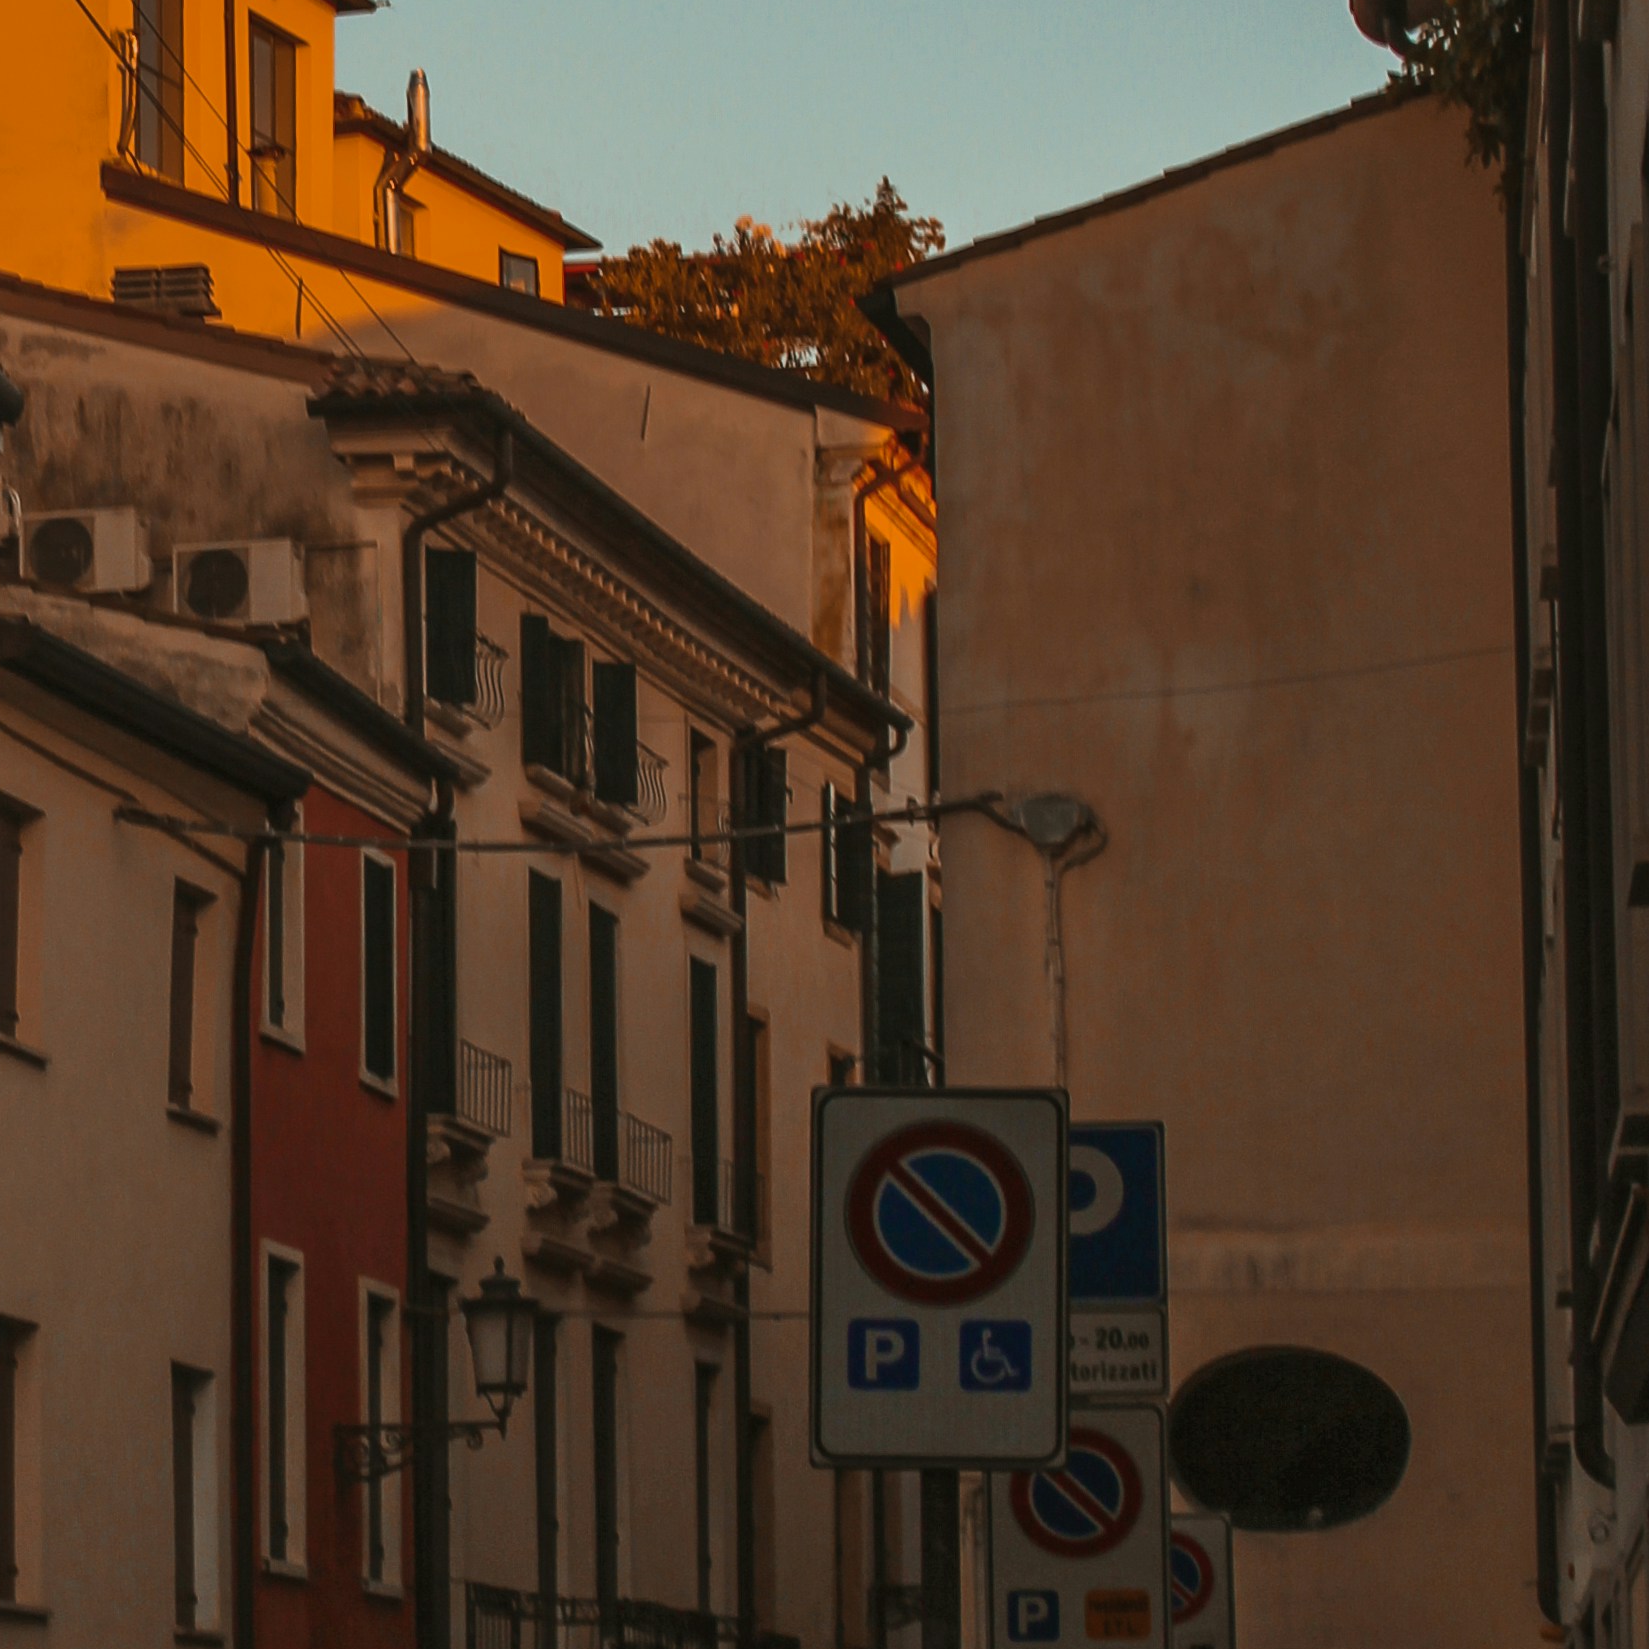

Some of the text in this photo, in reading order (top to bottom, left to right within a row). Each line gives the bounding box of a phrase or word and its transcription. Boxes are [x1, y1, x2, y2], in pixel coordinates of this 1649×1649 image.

[865, 1328, 906, 1381] P
[1095, 1327, 1149, 1350] 20.00
[1069, 1361, 1157, 1382] torizzati
[1017, 1596, 1049, 1637] P
